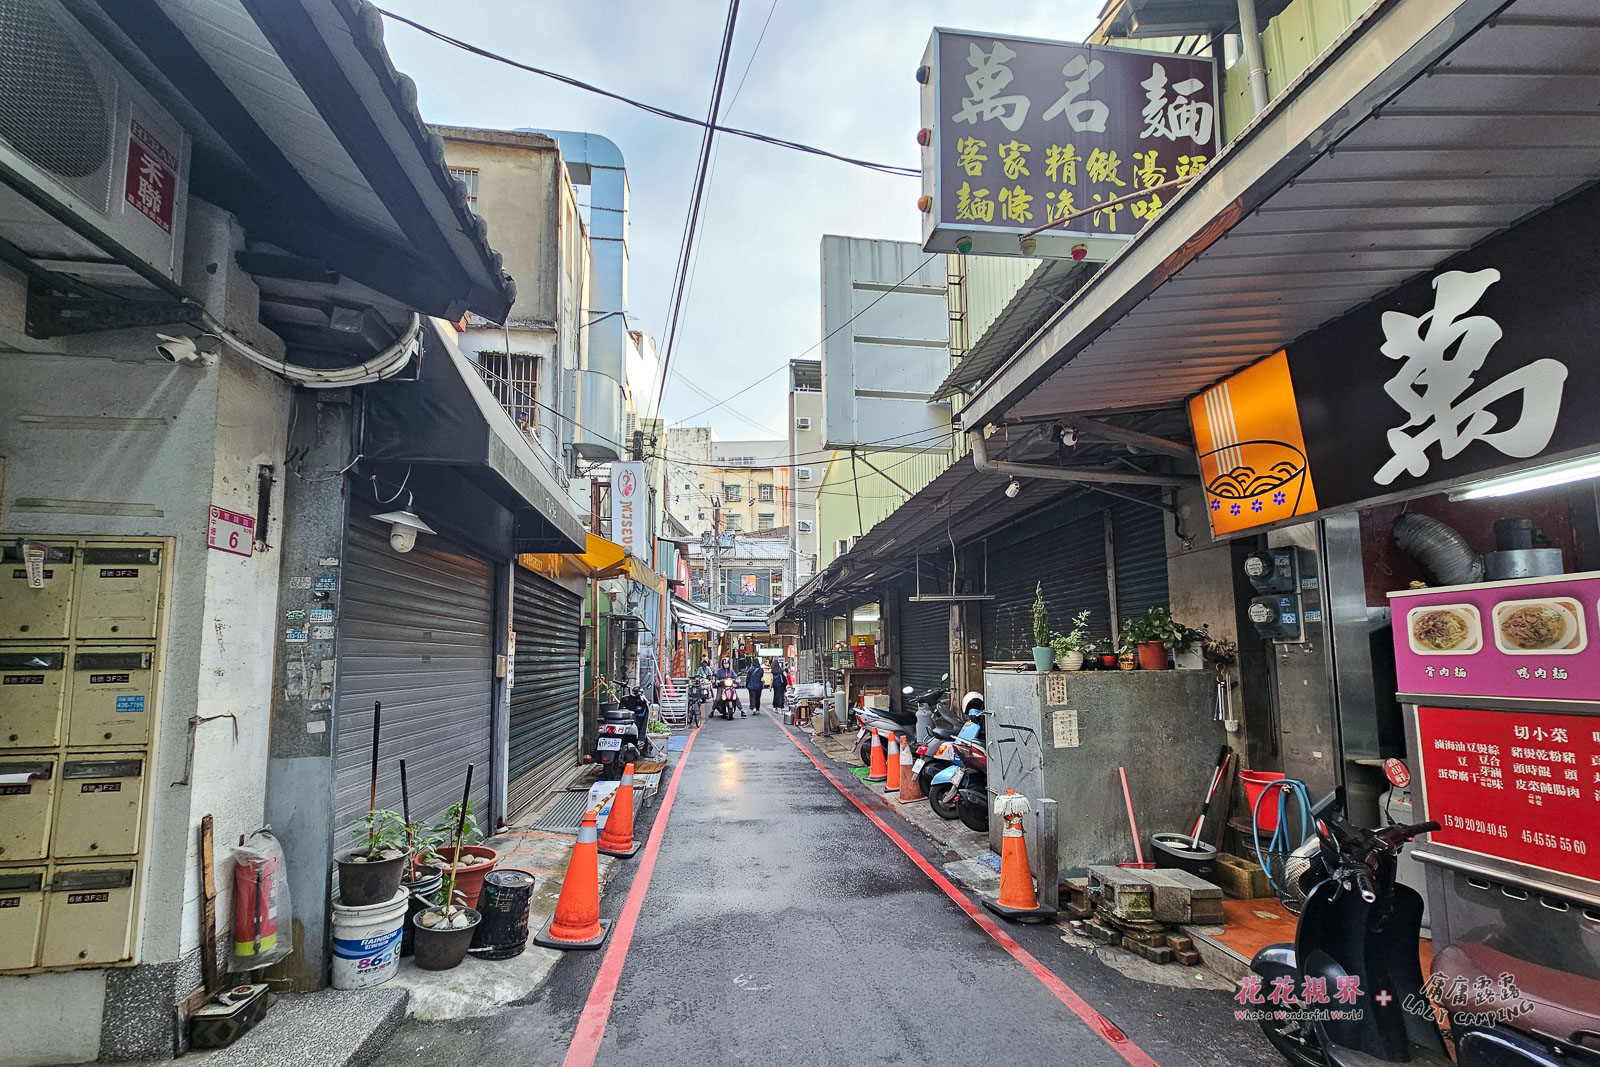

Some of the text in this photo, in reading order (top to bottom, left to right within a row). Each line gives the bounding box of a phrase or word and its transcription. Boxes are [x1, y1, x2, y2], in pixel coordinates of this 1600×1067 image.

[952, 41, 1214, 146] 萬名麵
[137, 153, 165, 213] 禾聯
[1373, 267, 1569, 486] 萬
[229, 531, 239, 549] 6
[1513, 725, 1568, 743] 切小菜
[1444, 814, 1508, 839] 15 20 20 20 40 45
[1521, 829, 1586, 855] 45 45 55 55 60
[361, 930, 397, 946] RAINBOW
